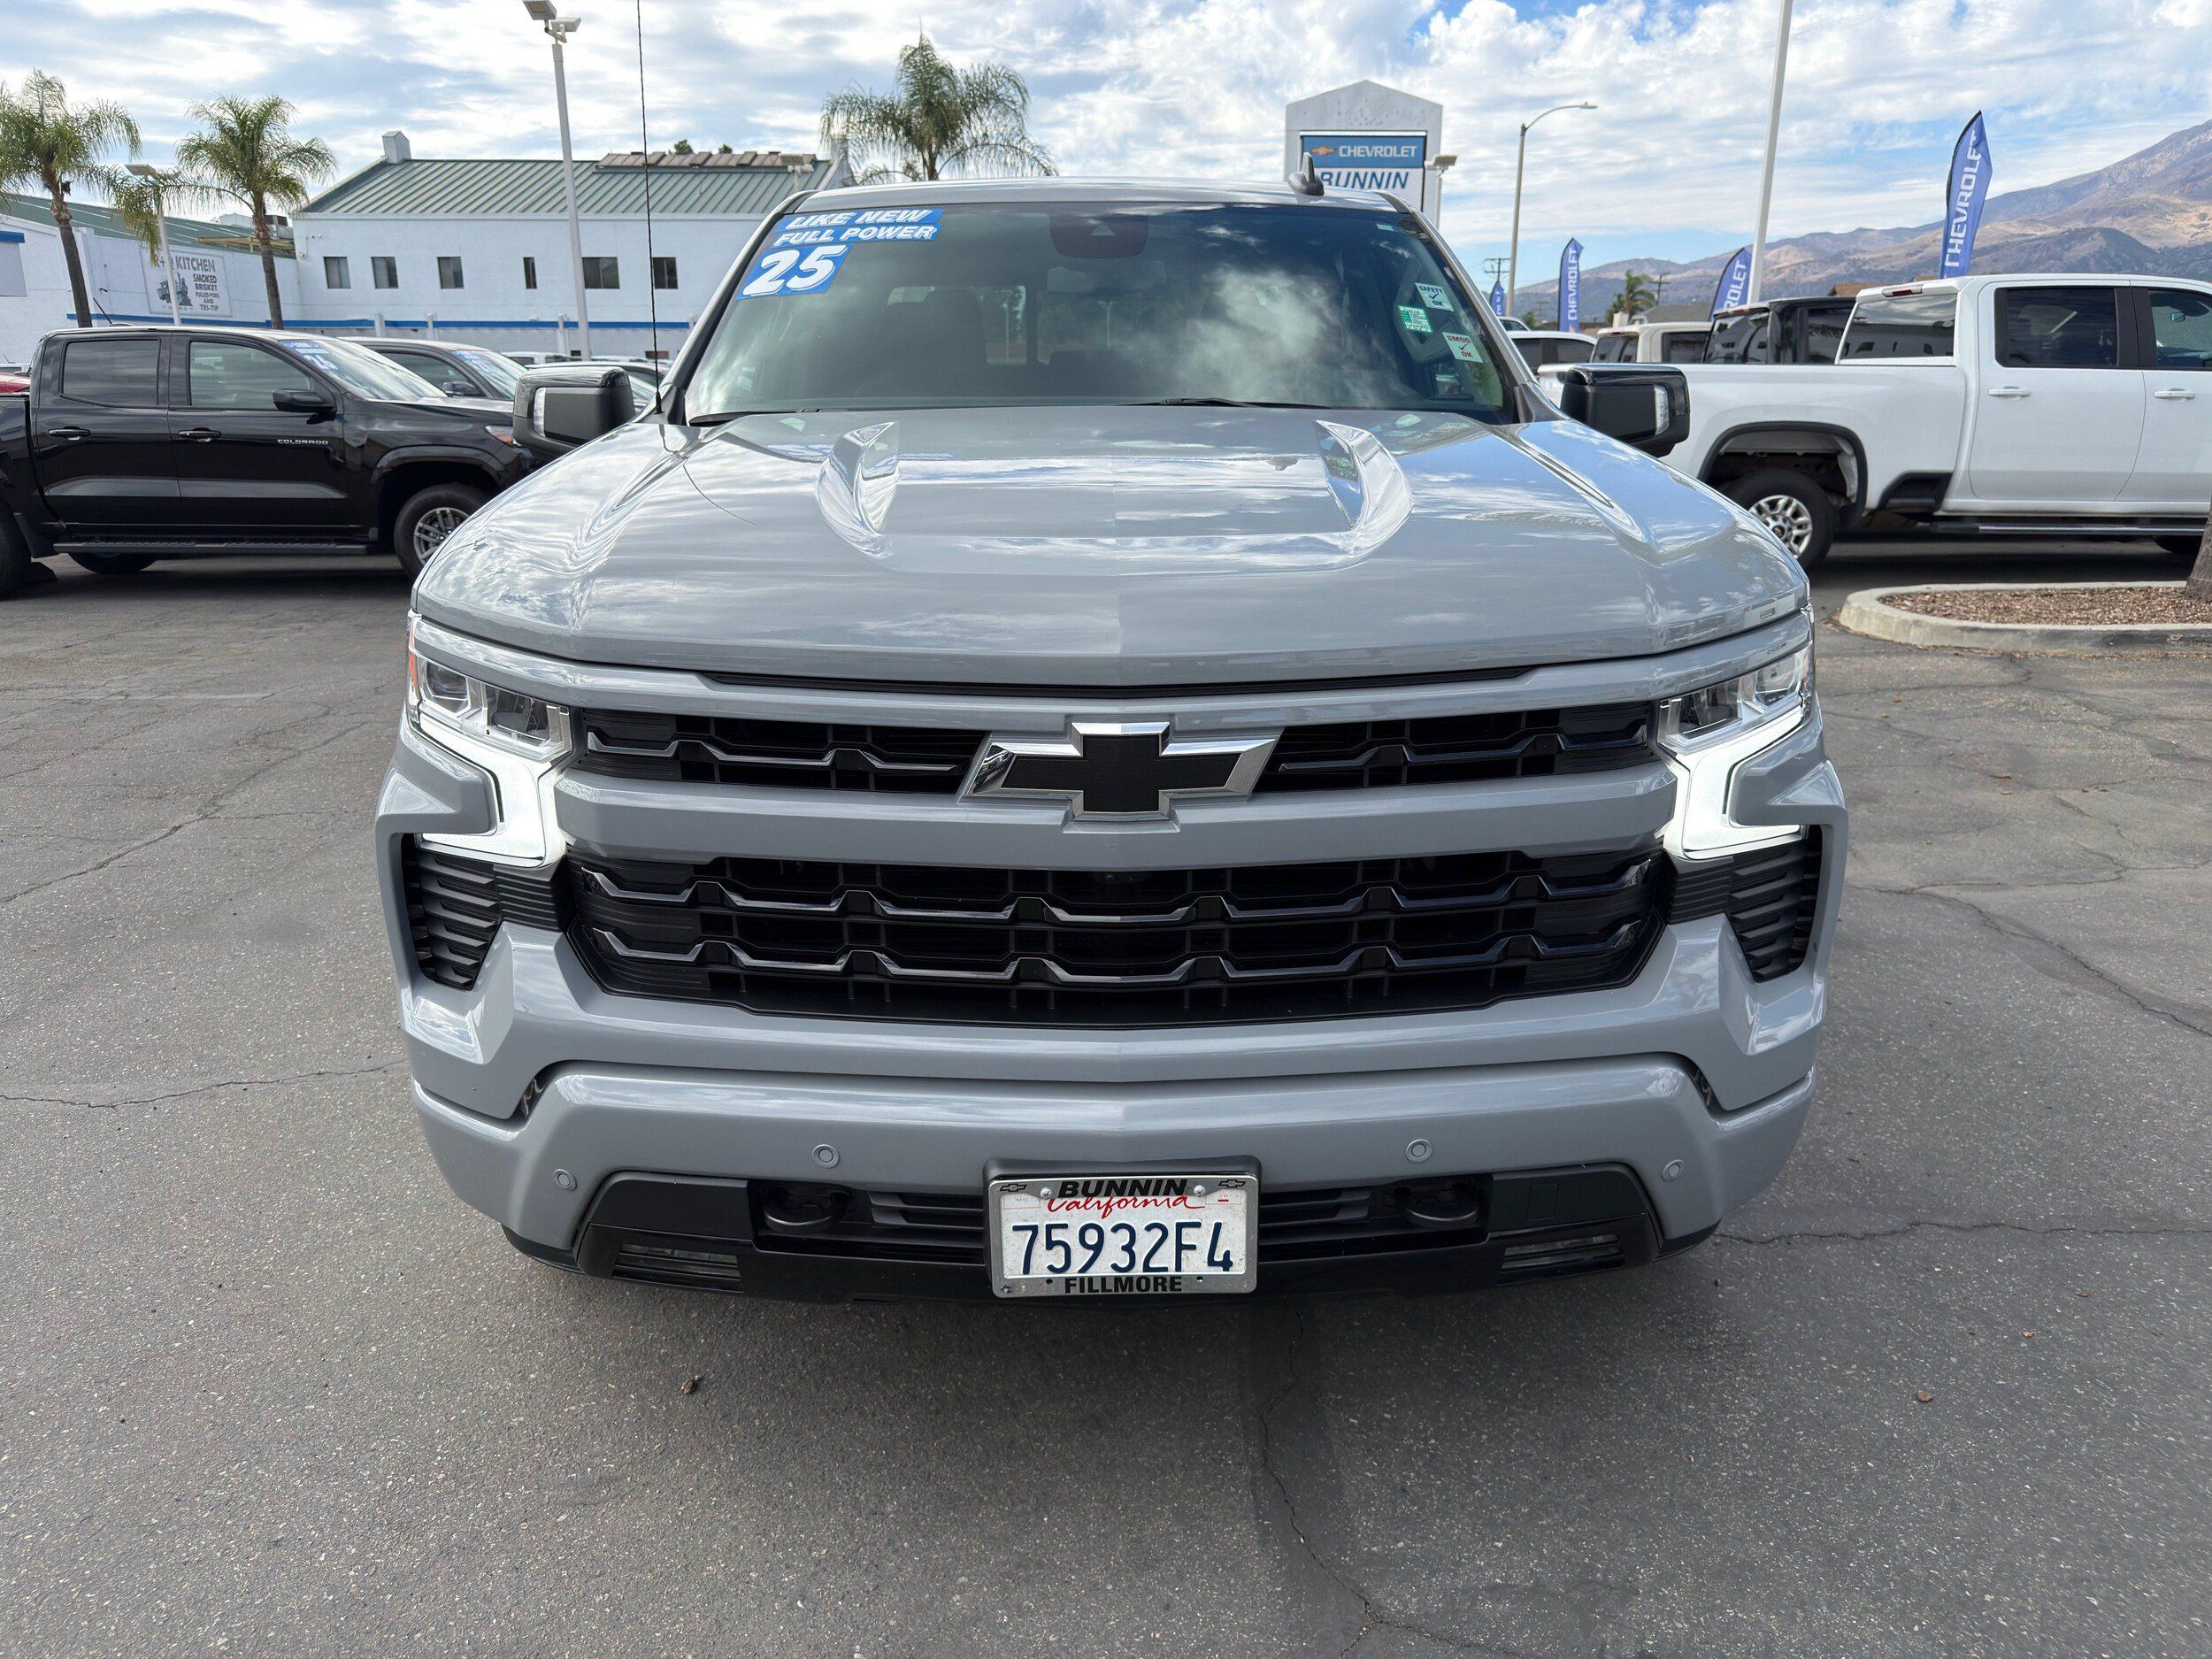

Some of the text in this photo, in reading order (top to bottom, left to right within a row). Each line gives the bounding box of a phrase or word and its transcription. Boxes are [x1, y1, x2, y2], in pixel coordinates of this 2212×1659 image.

[1339, 145, 1417, 157] CHEVROLET
[1320, 172, 1409, 189] BUNNIN
[786, 210, 933, 230] LIKE NEW
[772, 226, 938, 247] FULL POWER
[175, 255, 216, 273] KITCHEN
[742, 244, 848, 297] 25
[193, 273, 218, 283] SMOKED
[1567, 247, 1578, 320] CHEVROLET
[1057, 1179, 1187, 1197] BUNNIN
[1048, 1194, 1206, 1218] California
[1012, 1221, 1233, 1274] 75932F4
[1064, 1276, 1182, 1294] FILLMORE
